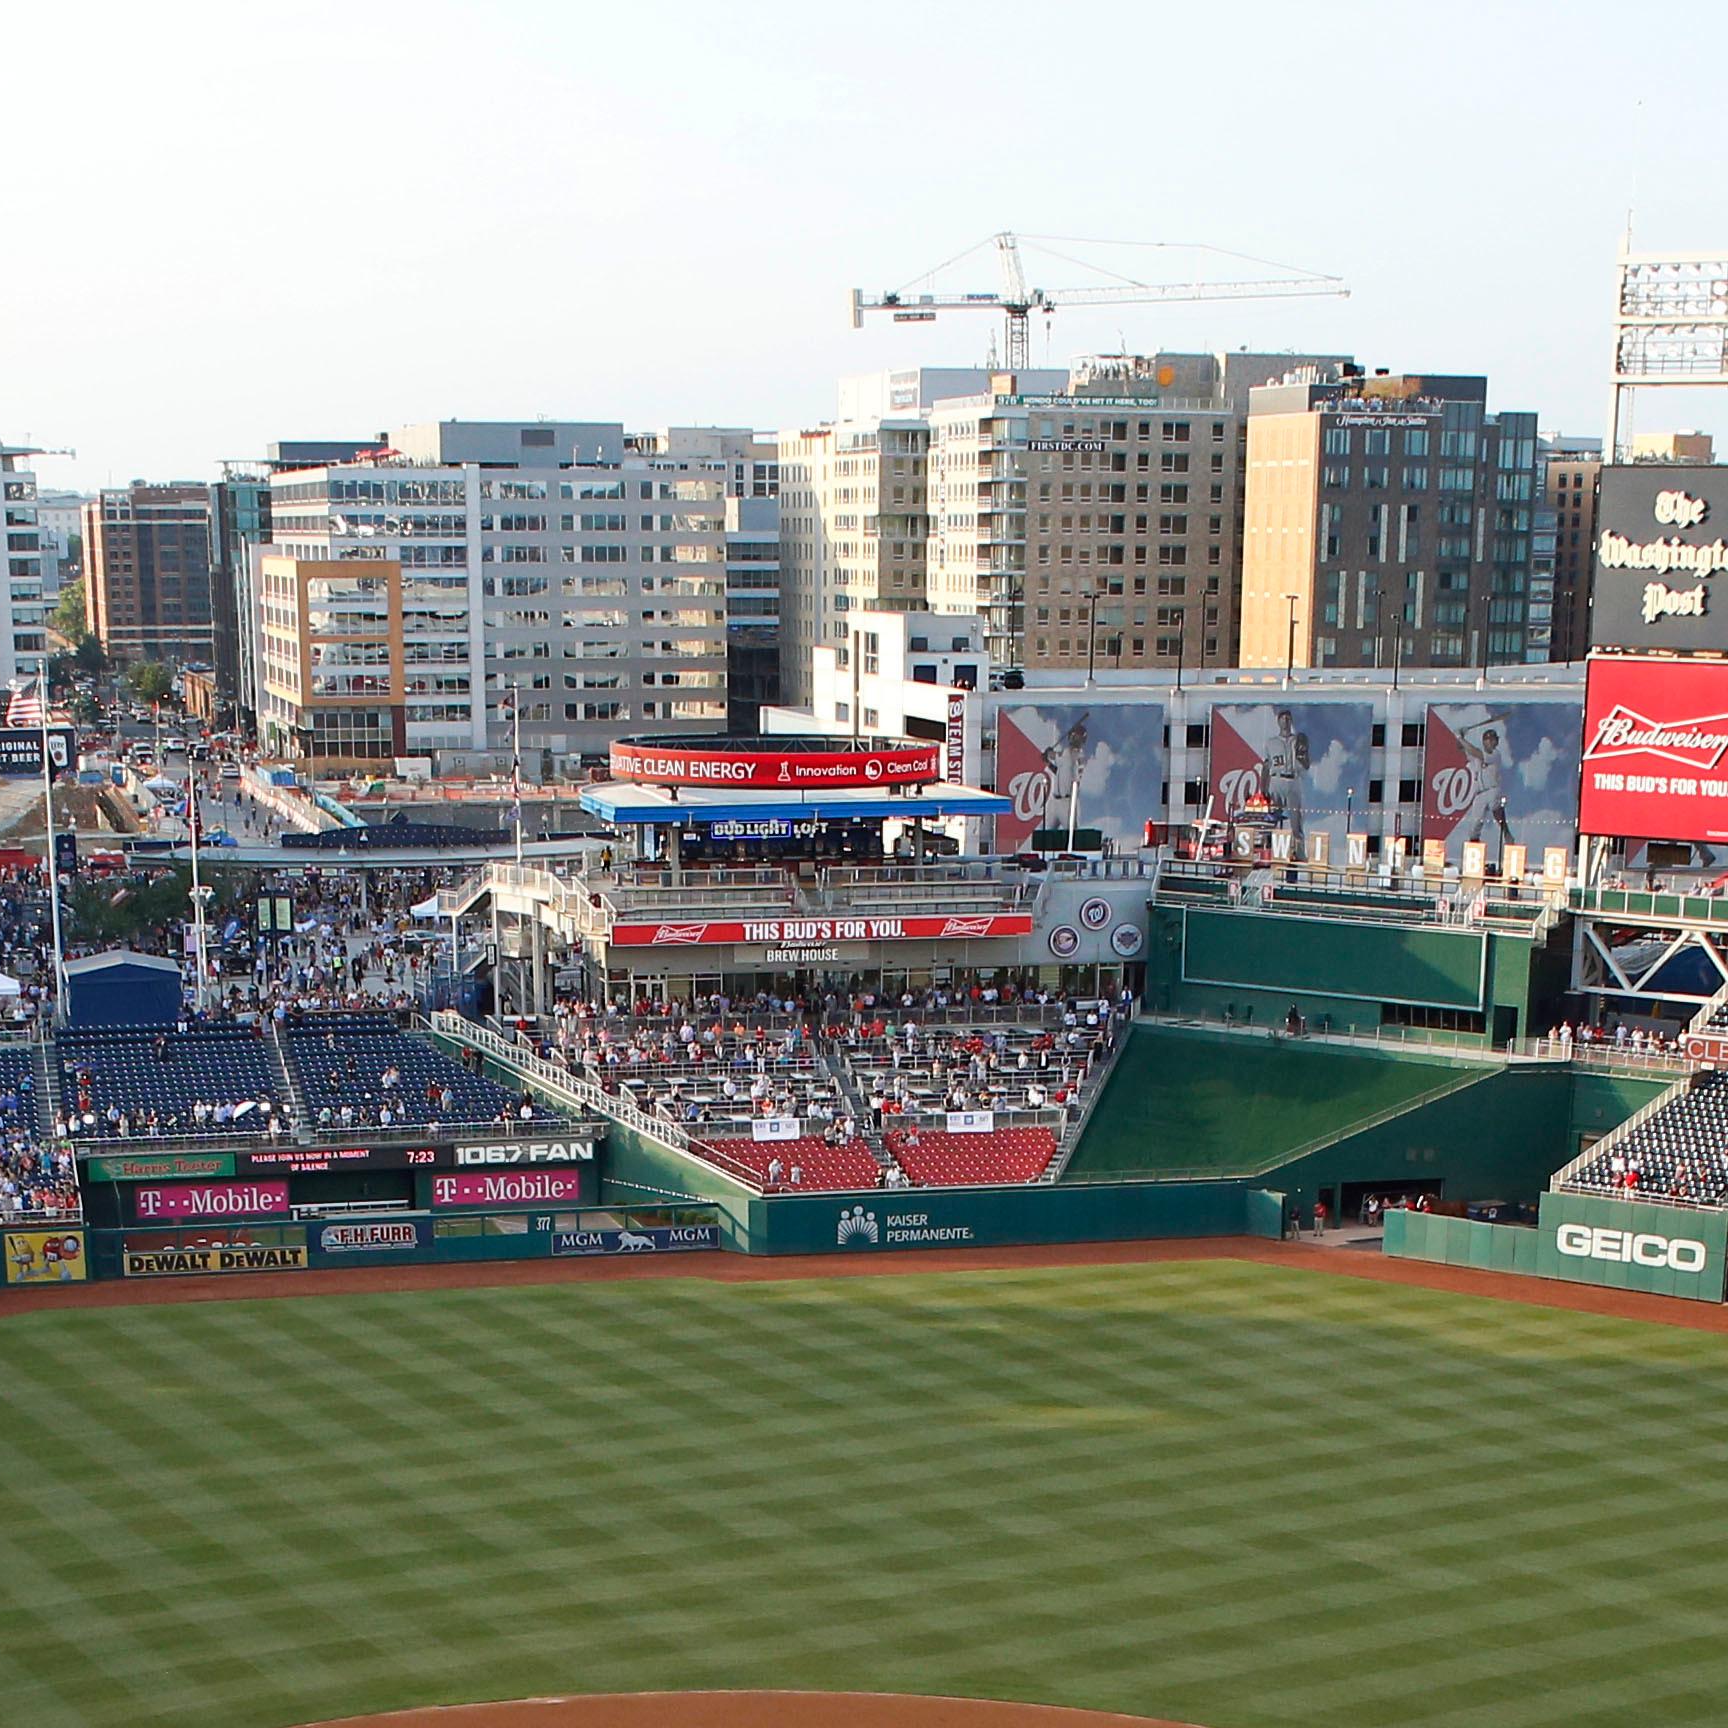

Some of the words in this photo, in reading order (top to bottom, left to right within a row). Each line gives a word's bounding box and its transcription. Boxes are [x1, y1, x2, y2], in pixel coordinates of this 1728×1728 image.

[1654, 490, 1706, 529] The
[1641, 582, 1706, 624] Post
[949, 720, 962, 757] TEAM
[11, 753, 40, 763] BEER
[643, 758, 685, 777] CLEAN
[690, 760, 756, 780] ENERGY
[795, 764, 857, 777] Innovation
[887, 762, 911, 774] Clean
[913, 761, 928, 772] Coal
[1594, 773, 1625, 791] THIS
[1626, 775, 1667, 793] BUD'S
[1669, 778, 1697, 795] FOR
[714, 822, 745, 836] BUD
[747, 822, 790, 836] LIGHT
[793, 823, 828, 836] LOFT
[1466, 846, 1564, 878] BIG
[743, 923, 781, 941] THIS
[783, 922, 831, 940] BUD'S
[835, 921, 866, 939] FOR
[870, 919, 906, 937] YOU.
[767, 950, 799, 962] BREW
[801, 949, 839, 961] HOUSE
[251, 1153, 276, 1163] PLEASE
[306, 1151, 322, 1161] NOW
[340, 1150, 370, 1160] MOMENT
[407, 1151, 435, 1164] 7:23
[528, 1142, 593, 1162] FAN
[123, 1161, 172, 1175] Harris
[174, 1158, 221, 1173] Teeter
[536, 1216, 551, 1232] 377
[887, 1214, 928, 1227] KAISER
[561, 1232, 603, 1247] MGM
[669, 1227, 710, 1242] MGM
[887, 1227, 970, 1242] PERMANENTE
[1556, 1223, 1707, 1273] GEICO
